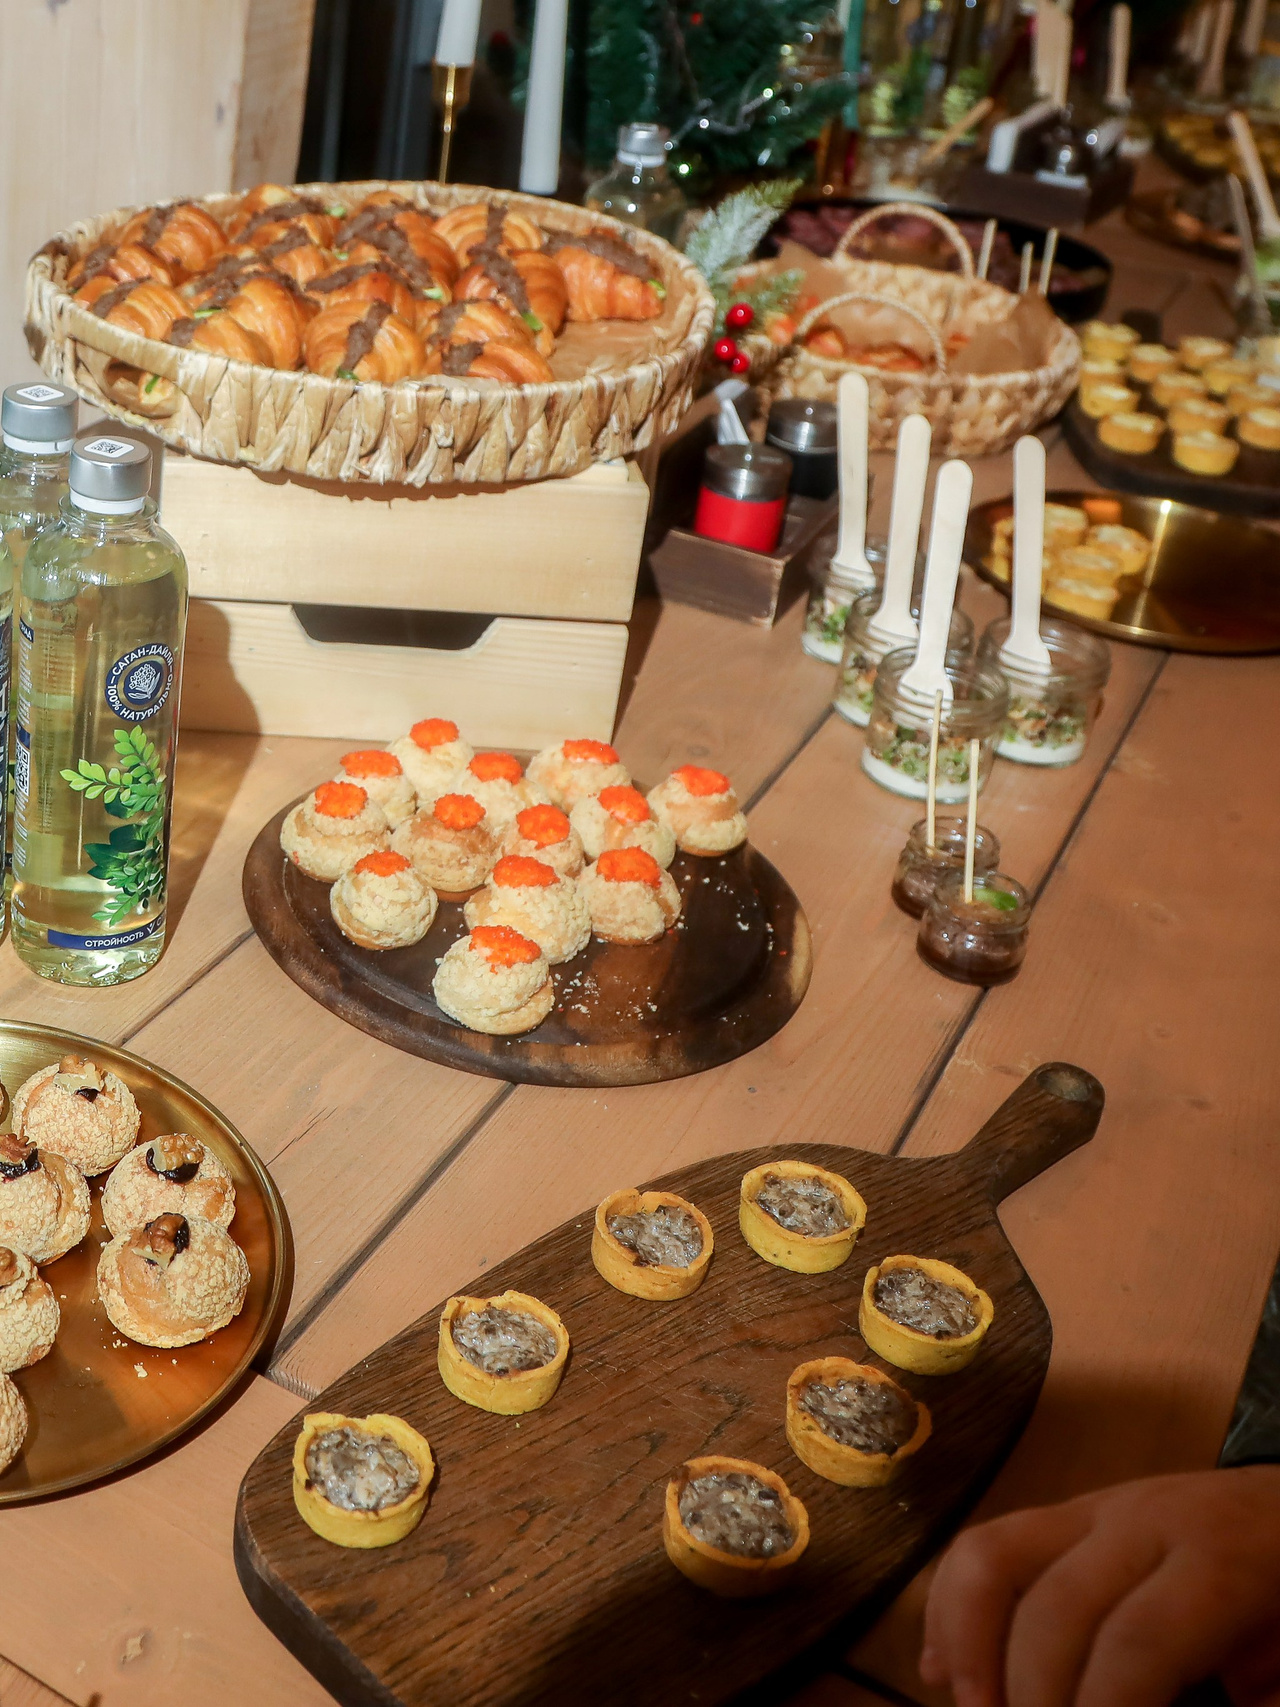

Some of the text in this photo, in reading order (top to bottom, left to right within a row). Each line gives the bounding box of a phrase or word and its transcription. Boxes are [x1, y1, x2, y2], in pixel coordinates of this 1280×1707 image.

[107, 673, 174, 721] 100% НАТУРАЛЬНО
[84, 931, 144, 948] СТРОЙНОСТЬ
